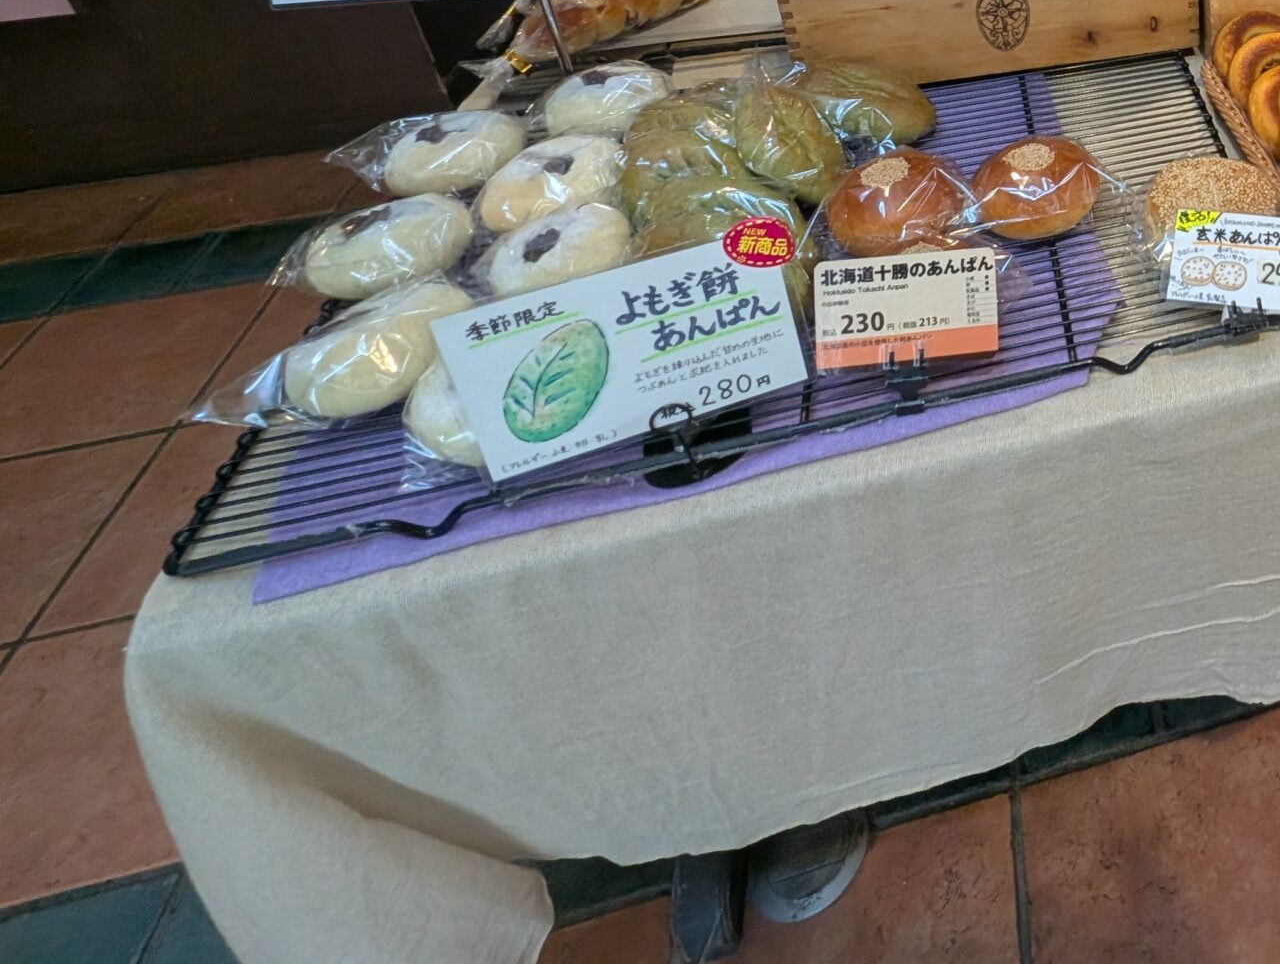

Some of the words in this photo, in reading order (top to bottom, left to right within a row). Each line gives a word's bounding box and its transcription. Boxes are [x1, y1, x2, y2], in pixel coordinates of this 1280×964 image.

[738, 234, 788, 256] 新商品
[742, 227, 766, 237] NEW
[820, 255, 994, 287] 北海道十勝のあんぱん
[615, 262, 740, 326] よもぎ餅
[823, 286, 856, 297] Hokkaido
[858, 284, 886, 294] Tokachi
[465, 300, 565, 341] 季節限定
[653, 296, 781, 351] あんぱん
[840, 311, 885, 335] 230
[698, 373, 753, 406] 280
